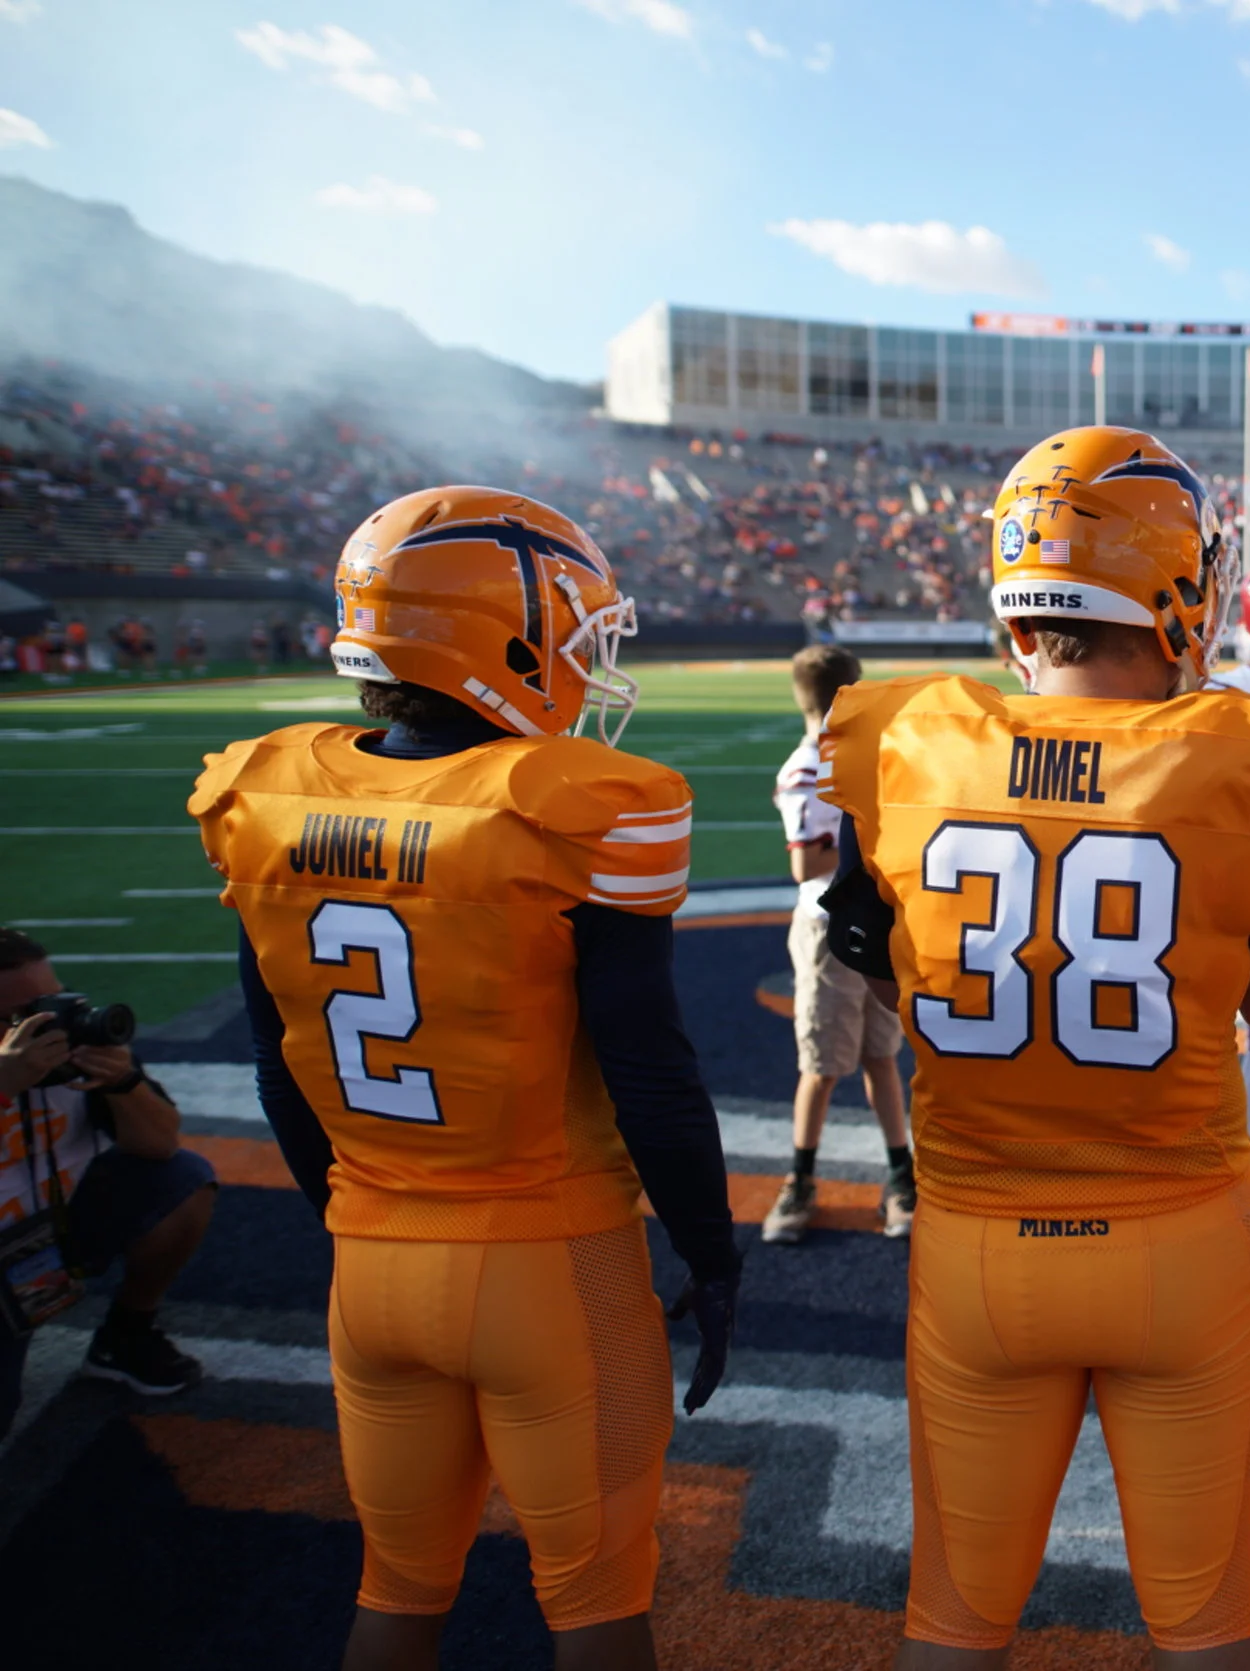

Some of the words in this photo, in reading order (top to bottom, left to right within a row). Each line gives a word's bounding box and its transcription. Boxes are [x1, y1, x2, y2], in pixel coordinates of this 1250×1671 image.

[1000, 592, 1083, 609] MINERS
[1008, 736, 1105, 804] DIMEL
[289, 812, 387, 881] JUNIEL
[398, 819, 432, 884] III
[912, 819, 1182, 1072] 38
[306, 898, 446, 1126] 2
